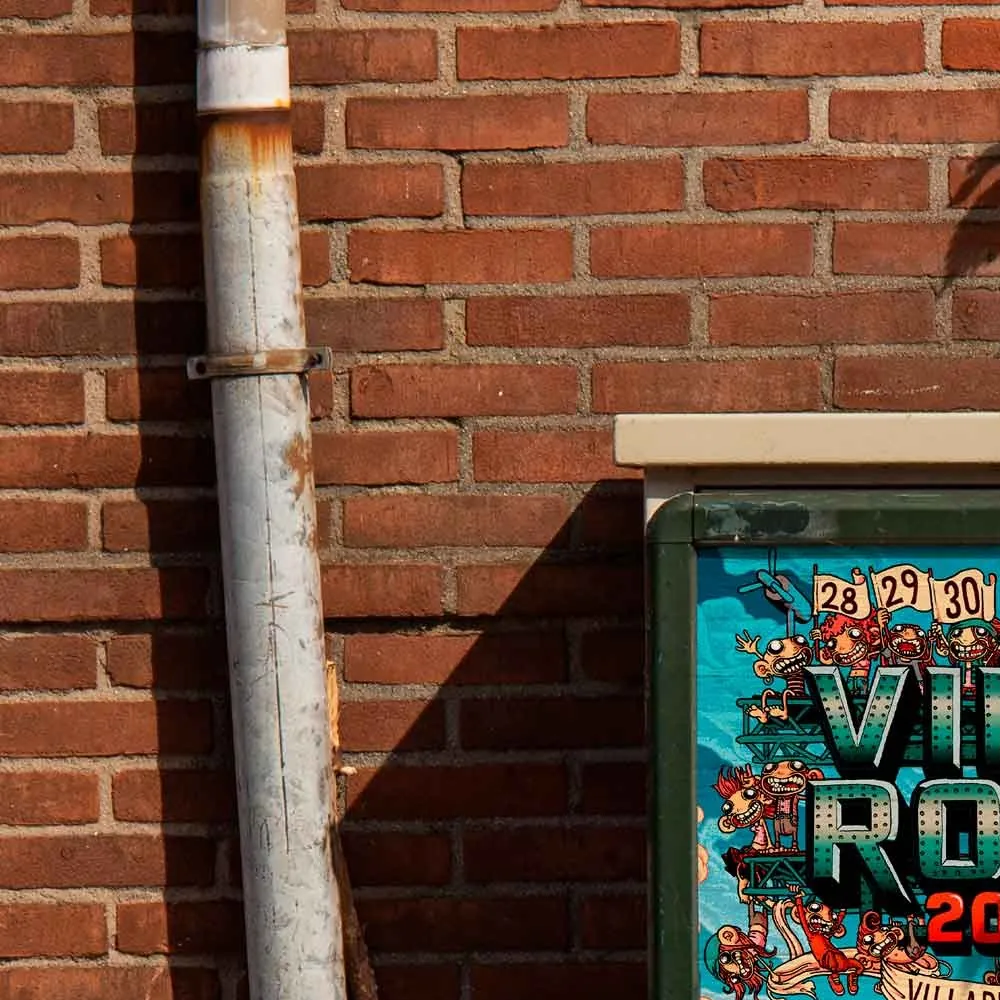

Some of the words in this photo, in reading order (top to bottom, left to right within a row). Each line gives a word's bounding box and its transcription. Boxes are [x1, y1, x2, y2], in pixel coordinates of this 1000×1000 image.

[821, 581, 858, 615] 28
[881, 569, 919, 608] 29
[944, 576, 981, 619] 30
